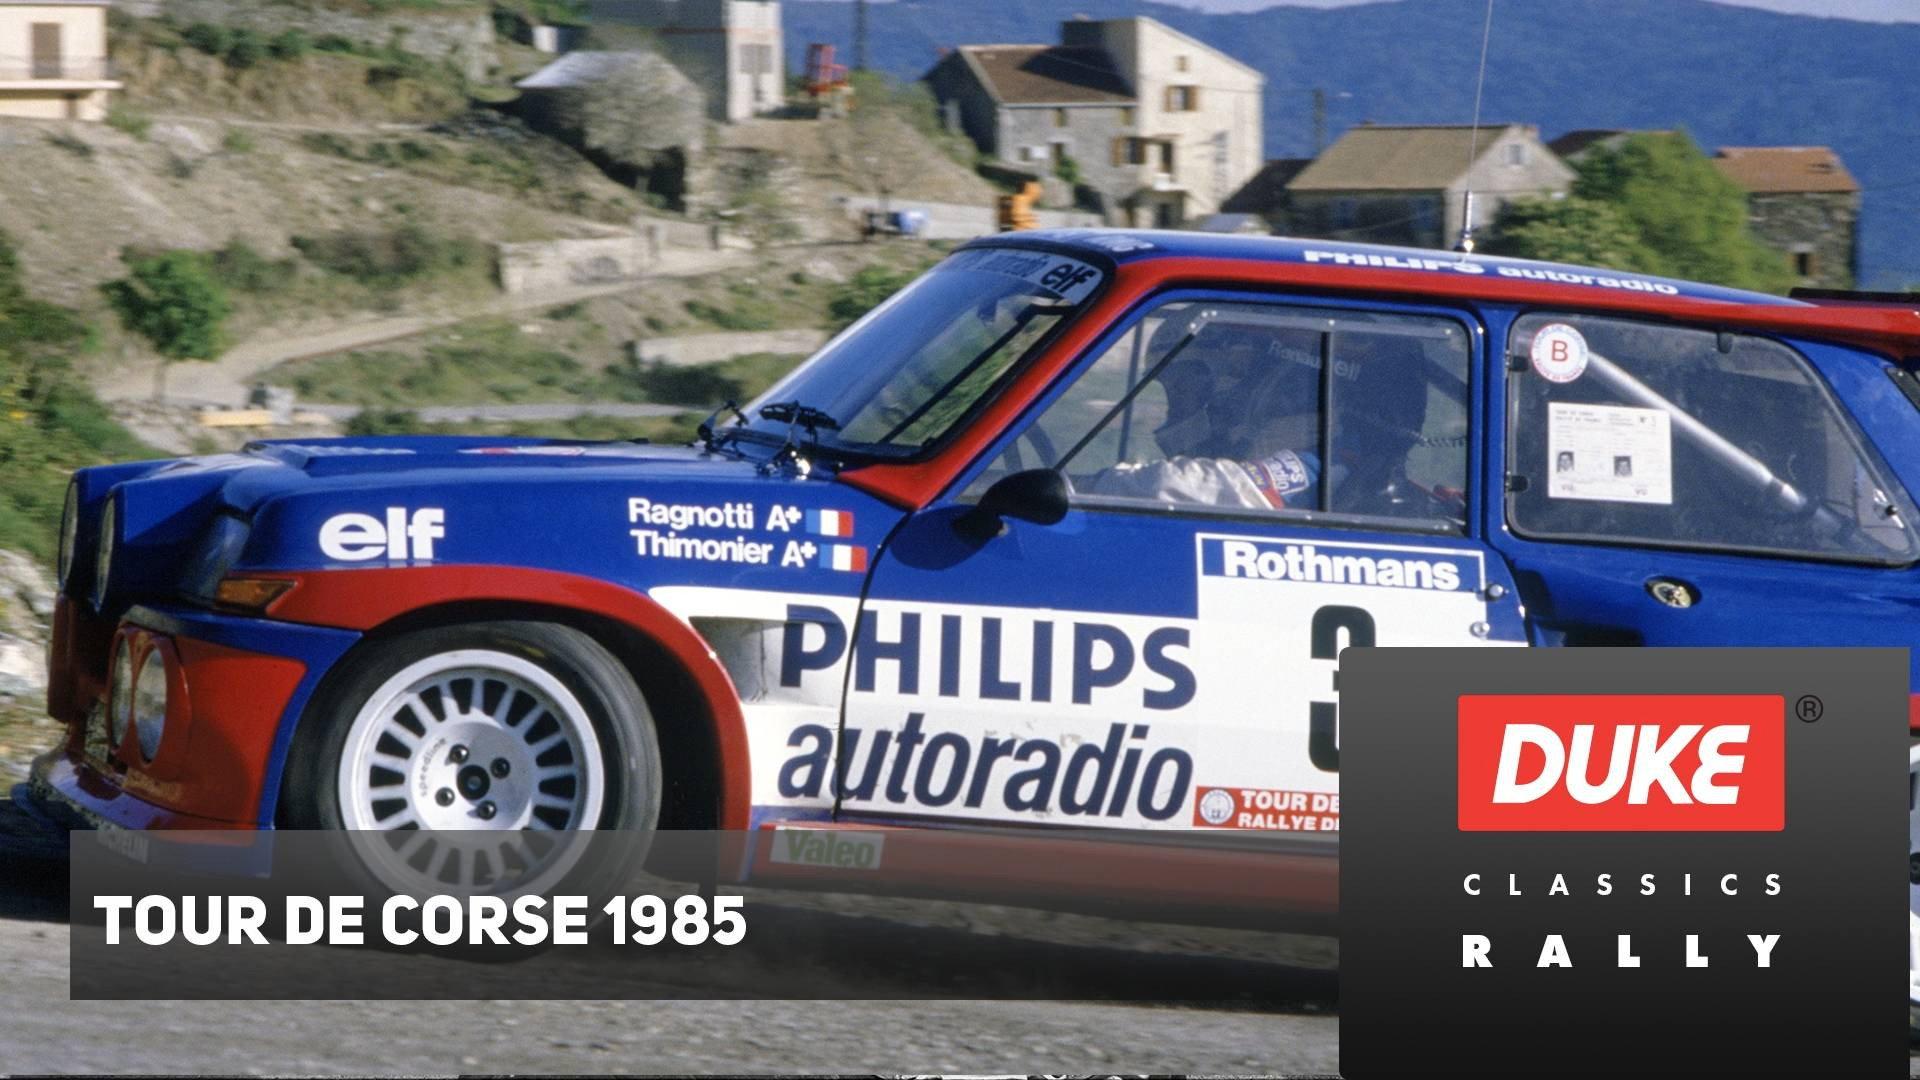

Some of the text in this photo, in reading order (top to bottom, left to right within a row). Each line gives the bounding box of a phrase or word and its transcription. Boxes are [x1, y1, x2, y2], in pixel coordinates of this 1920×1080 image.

[1039, 263, 1098, 293] elf
[1304, 250, 1679, 296] PHILIPS autoradio
[1552, 339, 1569, 362] B
[319, 507, 445, 561] elf
[628, 497, 802, 533] Ragnotti A+
[630, 529, 817, 568] Thimonier A+
[1223, 541, 1460, 590] Rothmans
[778, 603, 1198, 710] PHILIPS
[777, 712, 1194, 821] autoradio
[1241, 790, 1308, 811] TOUR
[1238, 811, 1317, 831] RALLYE
[784, 829, 876, 868] Valeo
